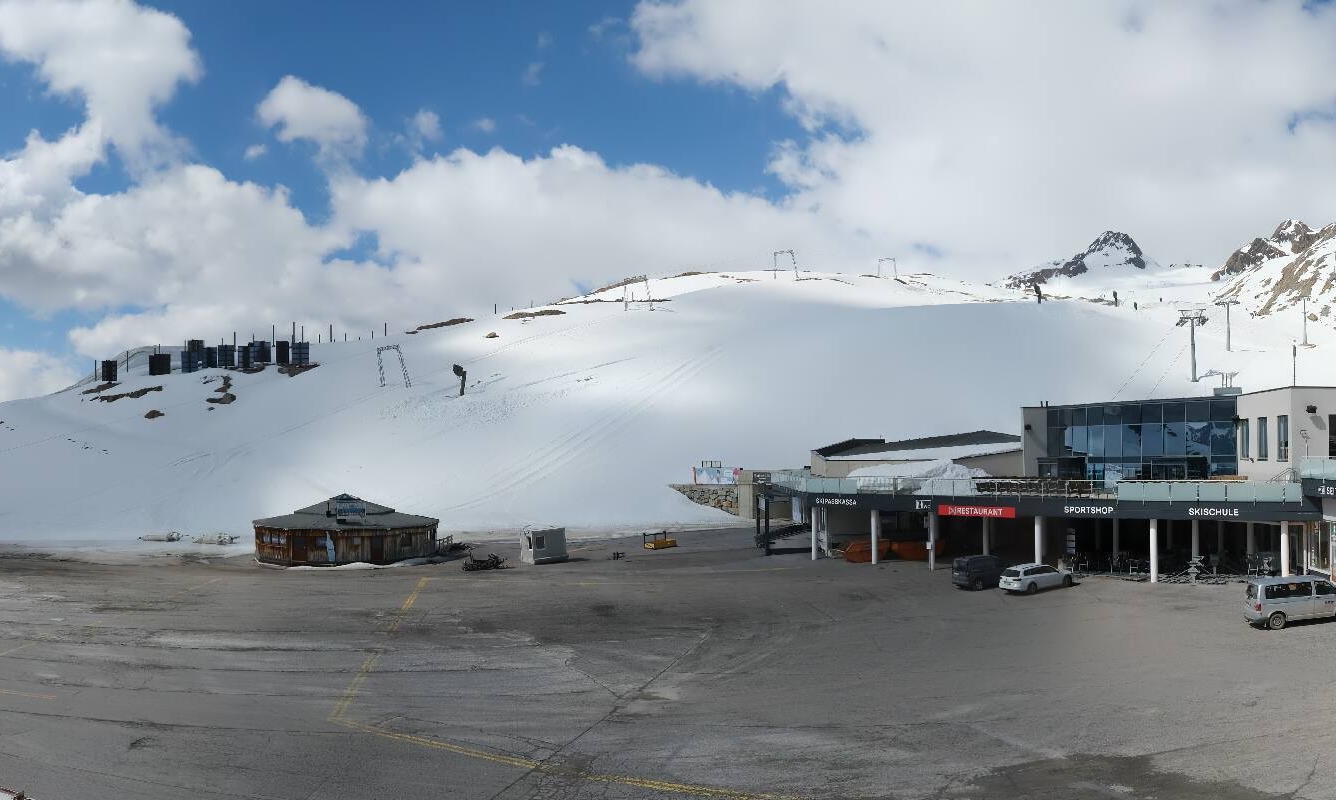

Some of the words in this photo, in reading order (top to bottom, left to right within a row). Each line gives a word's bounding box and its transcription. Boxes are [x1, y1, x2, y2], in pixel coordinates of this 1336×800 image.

[957, 507, 1003, 516] RESTAURANT
[1063, 505, 1113, 515] SPORTSHOP
[1188, 507, 1239, 516] SKISCHULE
